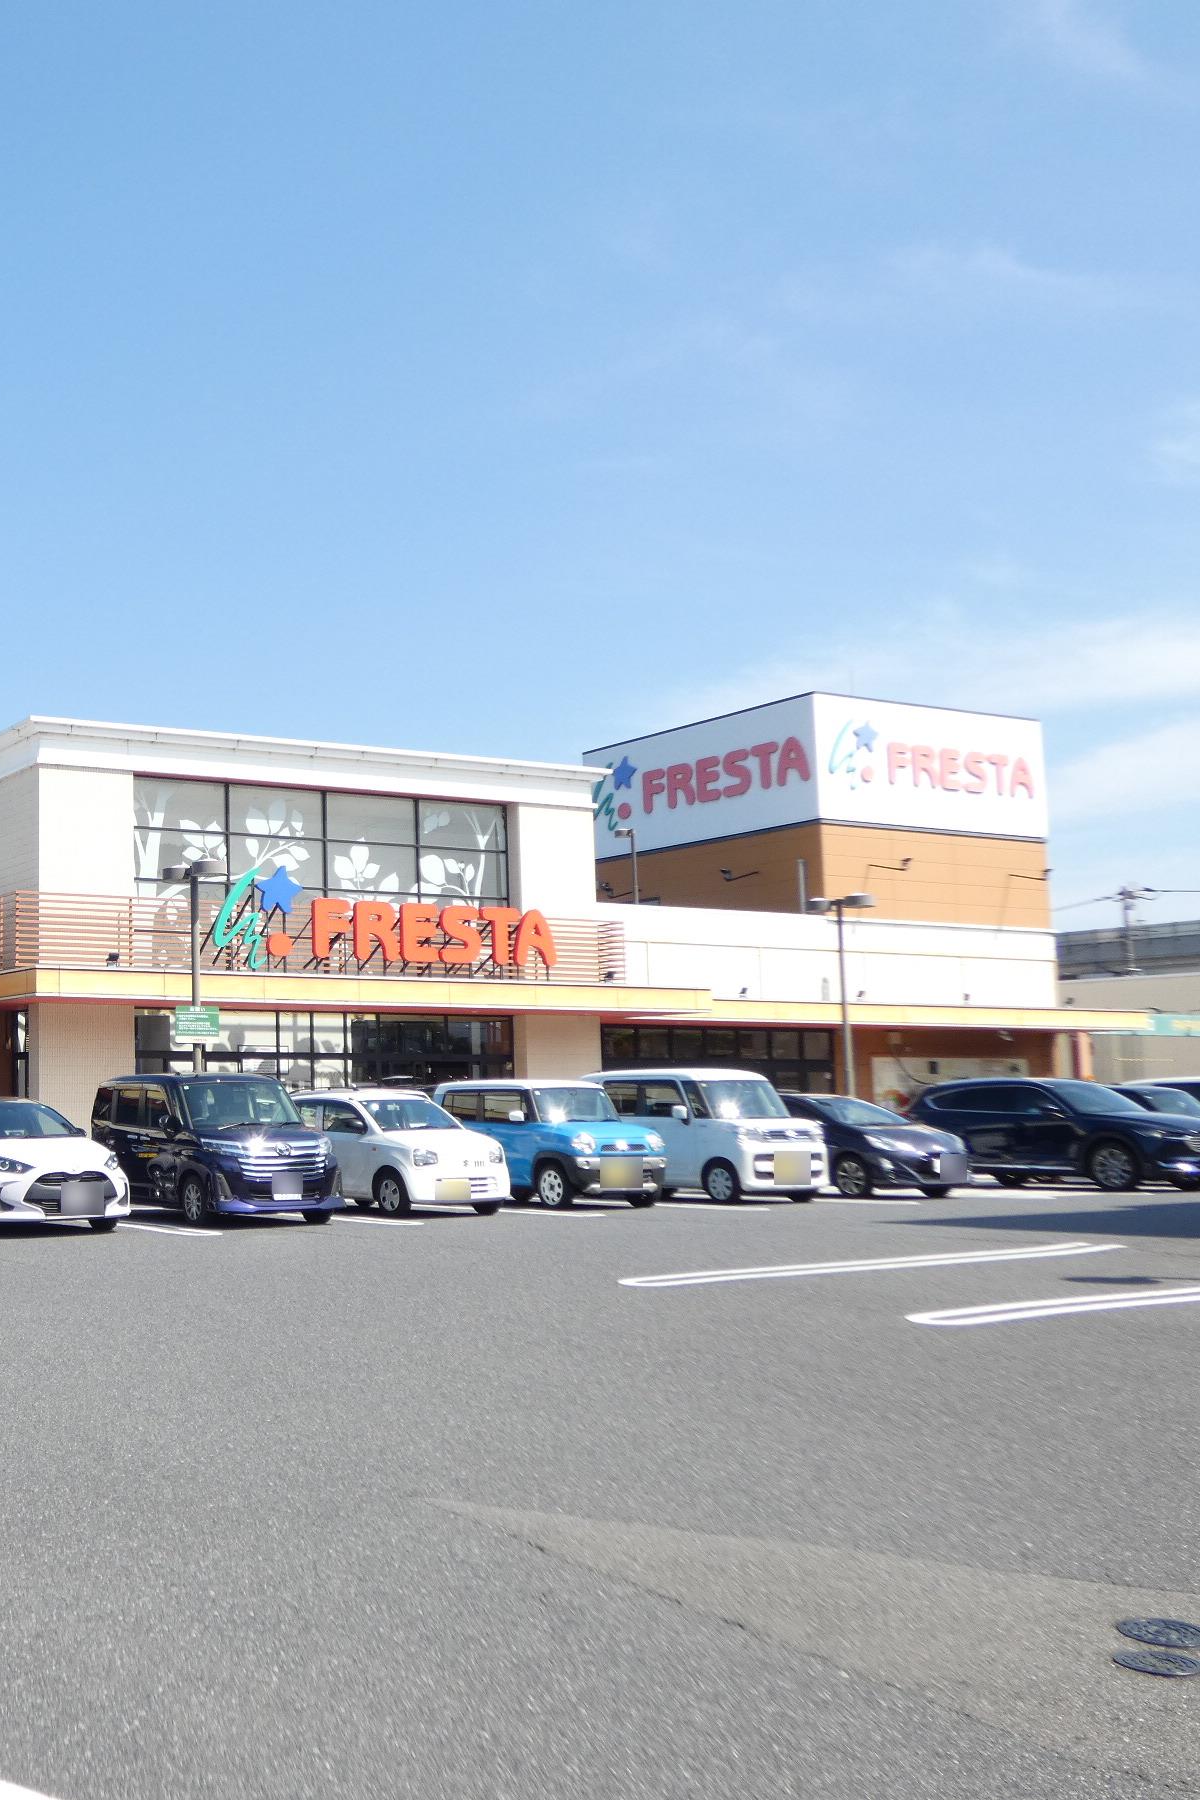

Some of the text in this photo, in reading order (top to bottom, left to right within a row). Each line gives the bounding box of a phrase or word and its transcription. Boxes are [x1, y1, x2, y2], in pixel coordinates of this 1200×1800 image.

[642, 736, 811, 813] FRESTA
[886, 742, 1035, 799] FRESTA
[311, 897, 558, 967] FRESTA
